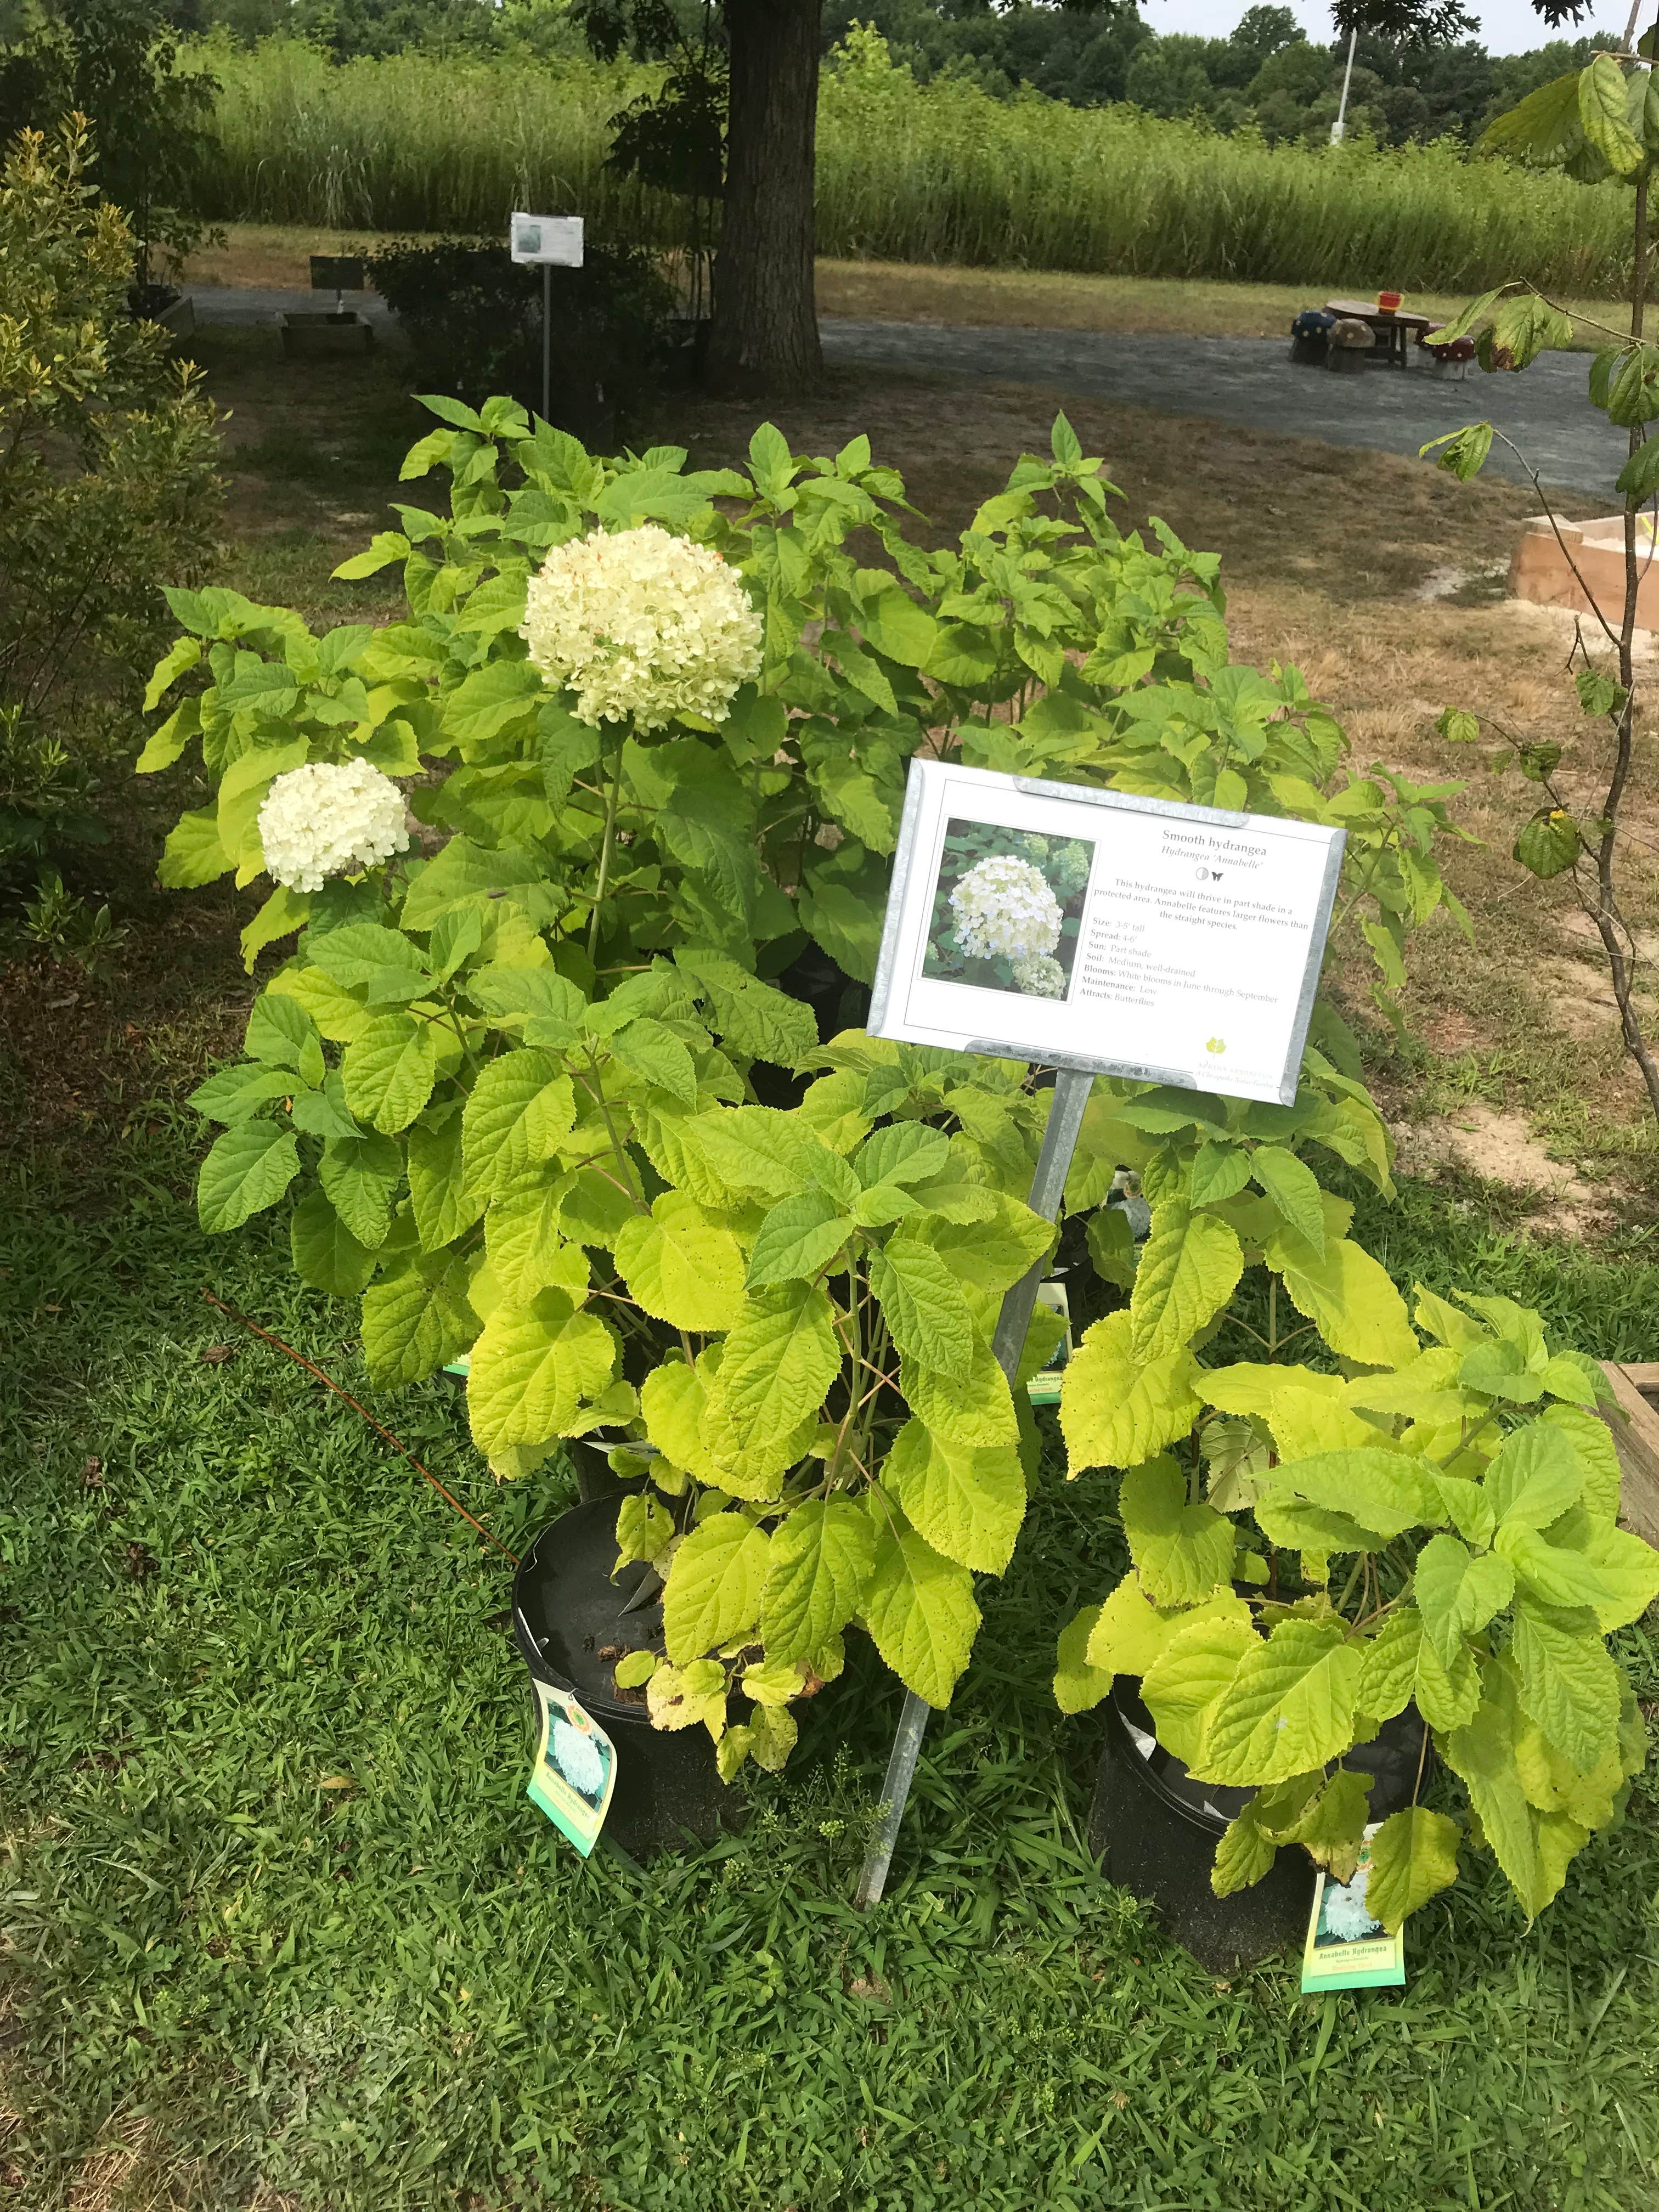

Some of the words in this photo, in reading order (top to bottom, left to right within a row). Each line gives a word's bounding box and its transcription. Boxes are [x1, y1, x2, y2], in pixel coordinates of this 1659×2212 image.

[1163, 830, 1205, 845] Smooth
[1209, 837, 1267, 856] hydrangea
[1161, 846, 1210, 862] Hydrangea
[1115, 878, 1132, 888] This
[1135, 882, 1177, 896] hydrangea
[1180, 890, 1195, 899] will
[1198, 892, 1222, 903] thrive
[1223, 896, 1232, 905] in
[1233, 900, 1250, 908] part
[1252, 902, 1276, 912] shade
[1278, 906, 1286, 914] in
[1094, 889, 1132, 900] protected
[1133, 895, 1152, 904] area.
[1154, 898, 1197, 911] Annabelle
[1199, 905, 1231, 917] features
[1233, 911, 1256, 922] larger
[1259, 915, 1289, 927] flowers
[1290, 921, 1309, 930] than
[1092, 917, 1112, 927] Size:
[1132, 924, 1146, 933] tall
[1160, 911, 1172, 919] the
[1175, 914, 1205, 925] straight
[1207, 920, 1238, 930] species.
[1091, 928, 1121, 941] Spread:
[1088, 941, 1107, 951] Sun:
[1111, 944, 1127, 954] Part
[1128, 948, 1152, 958] shade
[1086, 952, 1104, 962] Soil:
[1109, 956, 1143, 970] Medium,
[1146, 964, 1196, 978] well-drained
[1081, 975, 1136, 992] Maintenance:
[1139, 985, 1157, 995] Low
[1084, 964, 1116, 977] Blooms:
[1119, 969, 1142, 980] White
[1143, 974, 1172, 986] blooms
[1173, 979, 1182, 988] in
[1183, 980, 1202, 991] June
[1203, 984, 1234, 997] through
[1236, 990, 1278, 1003] September
[1079, 988, 1113, 1000] Attracts:
[1114, 993, 1155, 1006] Butterflies
[1319, 1950, 1350, 1960] Annabelle
[1352, 1946, 1387, 1956] Hydrangea
